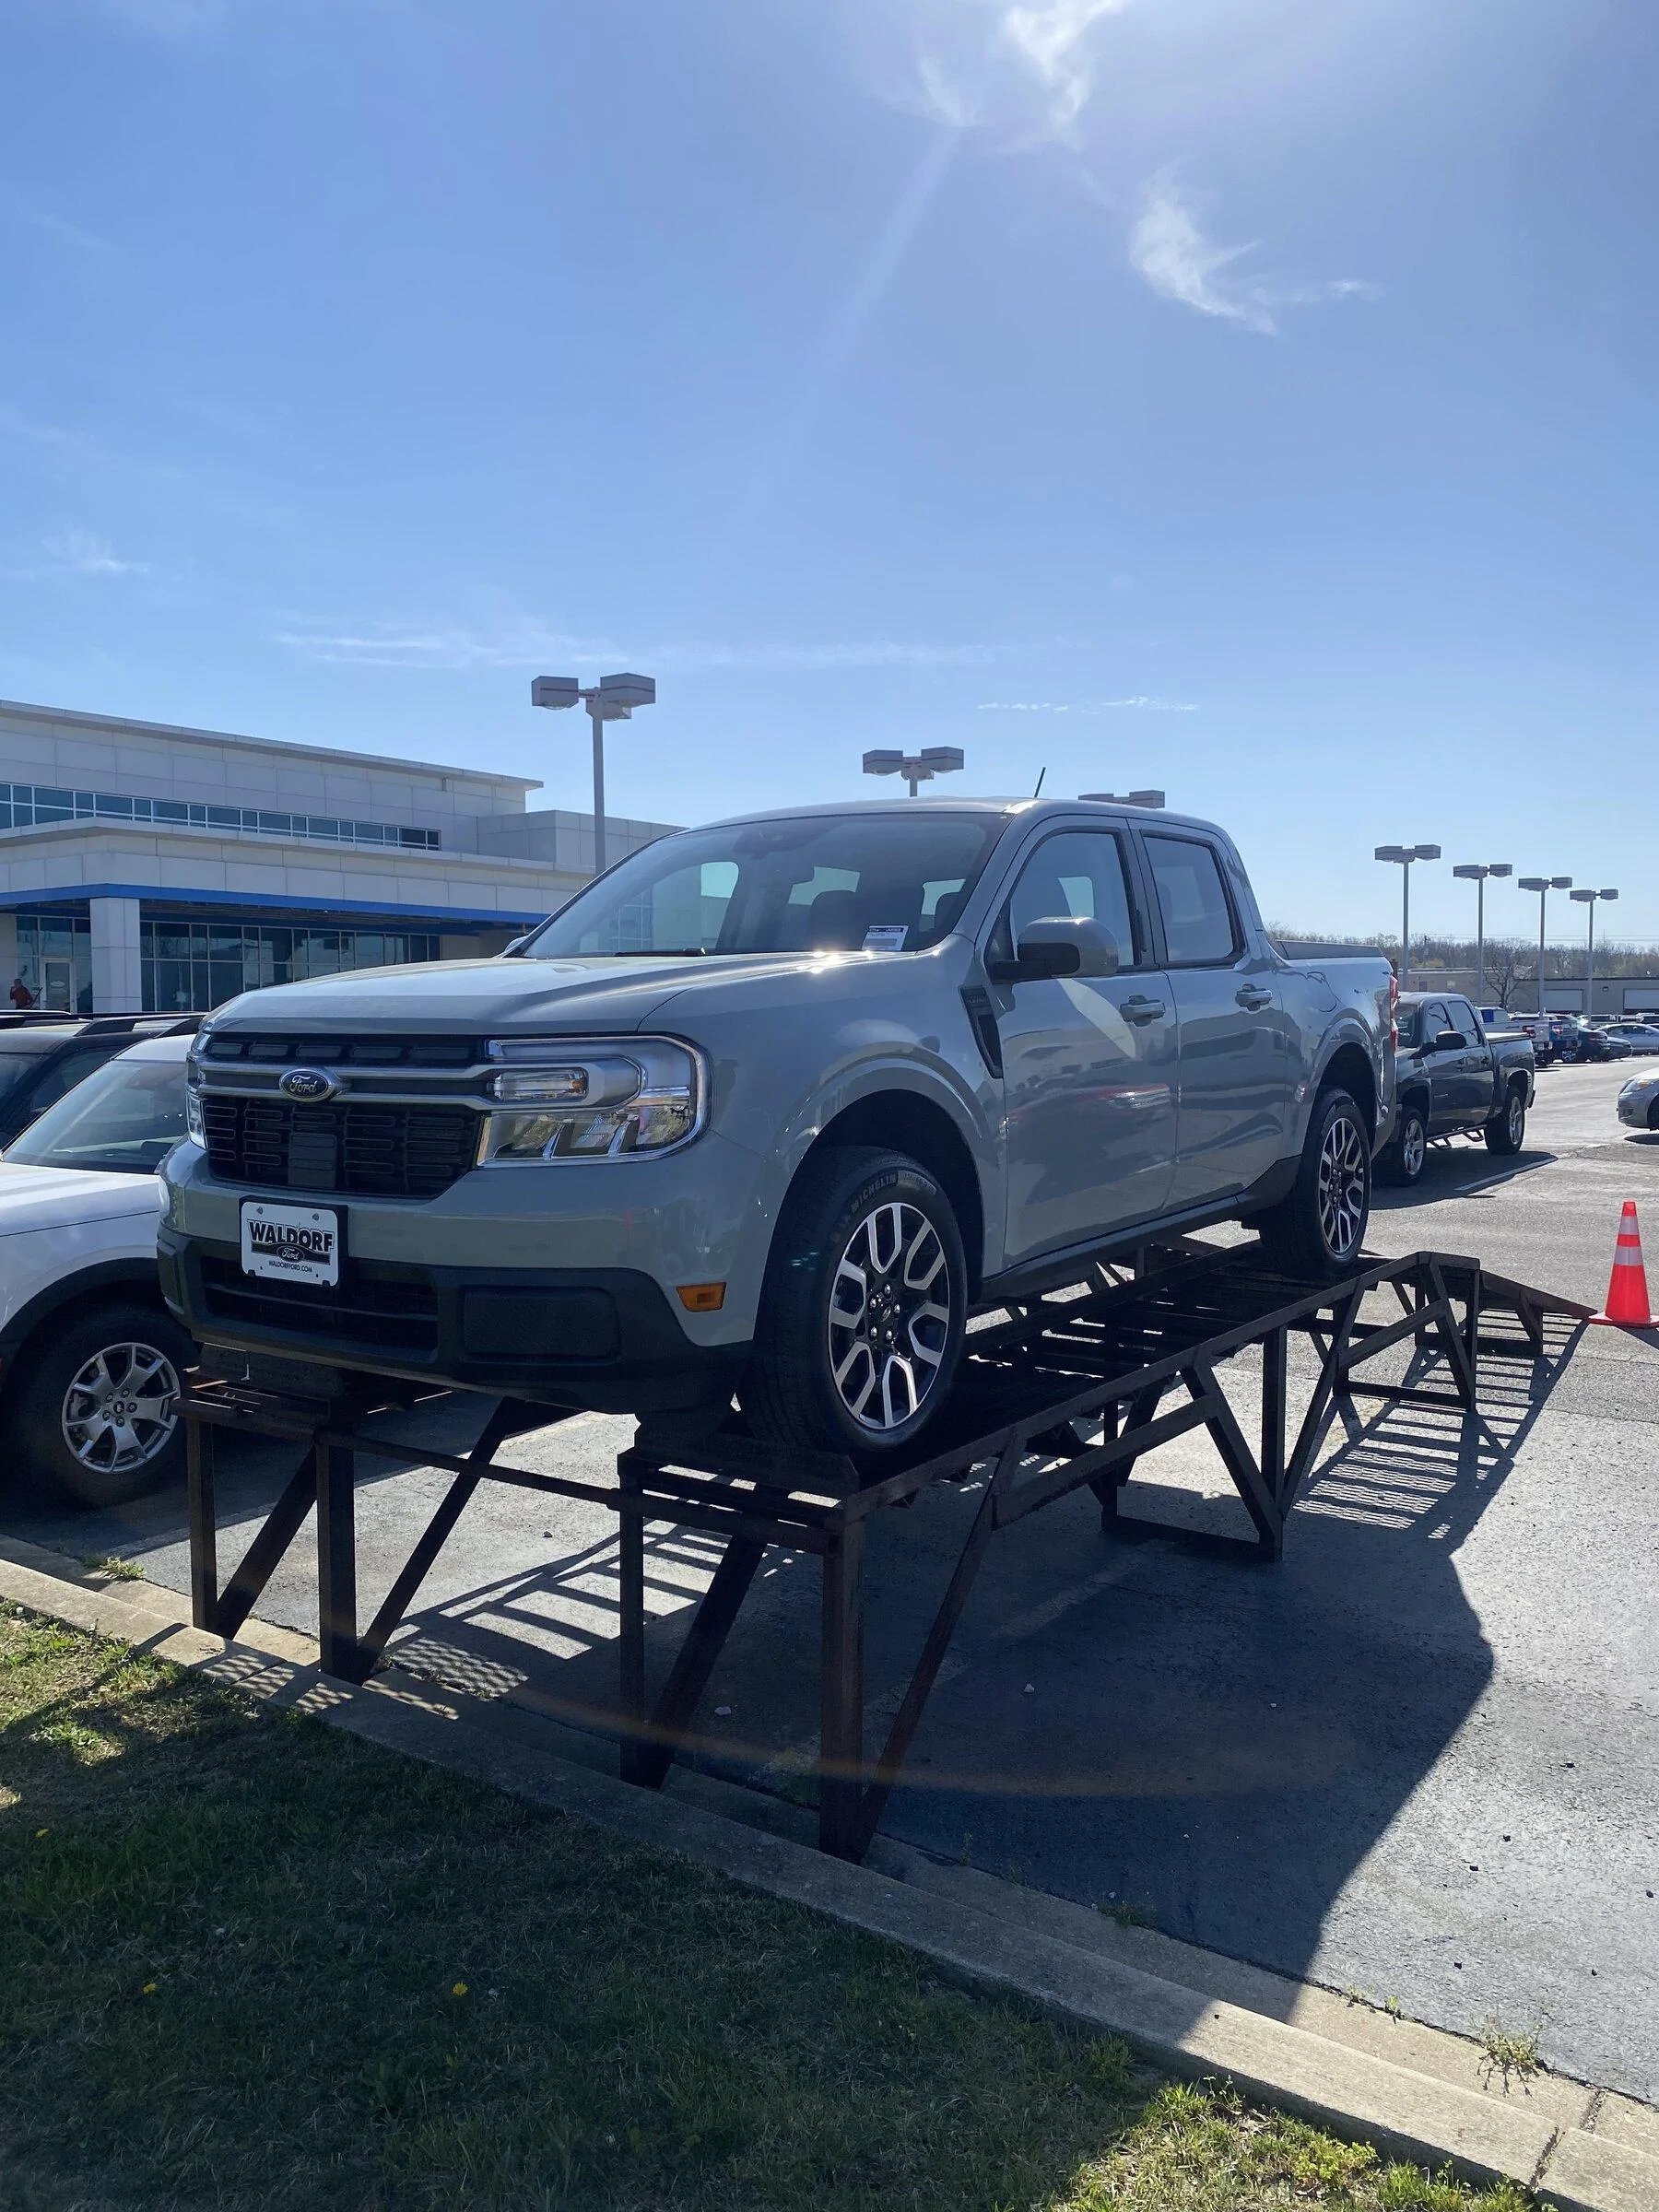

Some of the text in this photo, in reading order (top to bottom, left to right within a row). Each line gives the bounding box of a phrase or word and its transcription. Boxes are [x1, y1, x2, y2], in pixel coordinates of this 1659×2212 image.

[289, 1075, 318, 1093] Ford
[850, 1171, 898, 1214] MICHELIN
[247, 1219, 335, 1253] WALDORF
[281, 1247, 300, 1260] Ford
